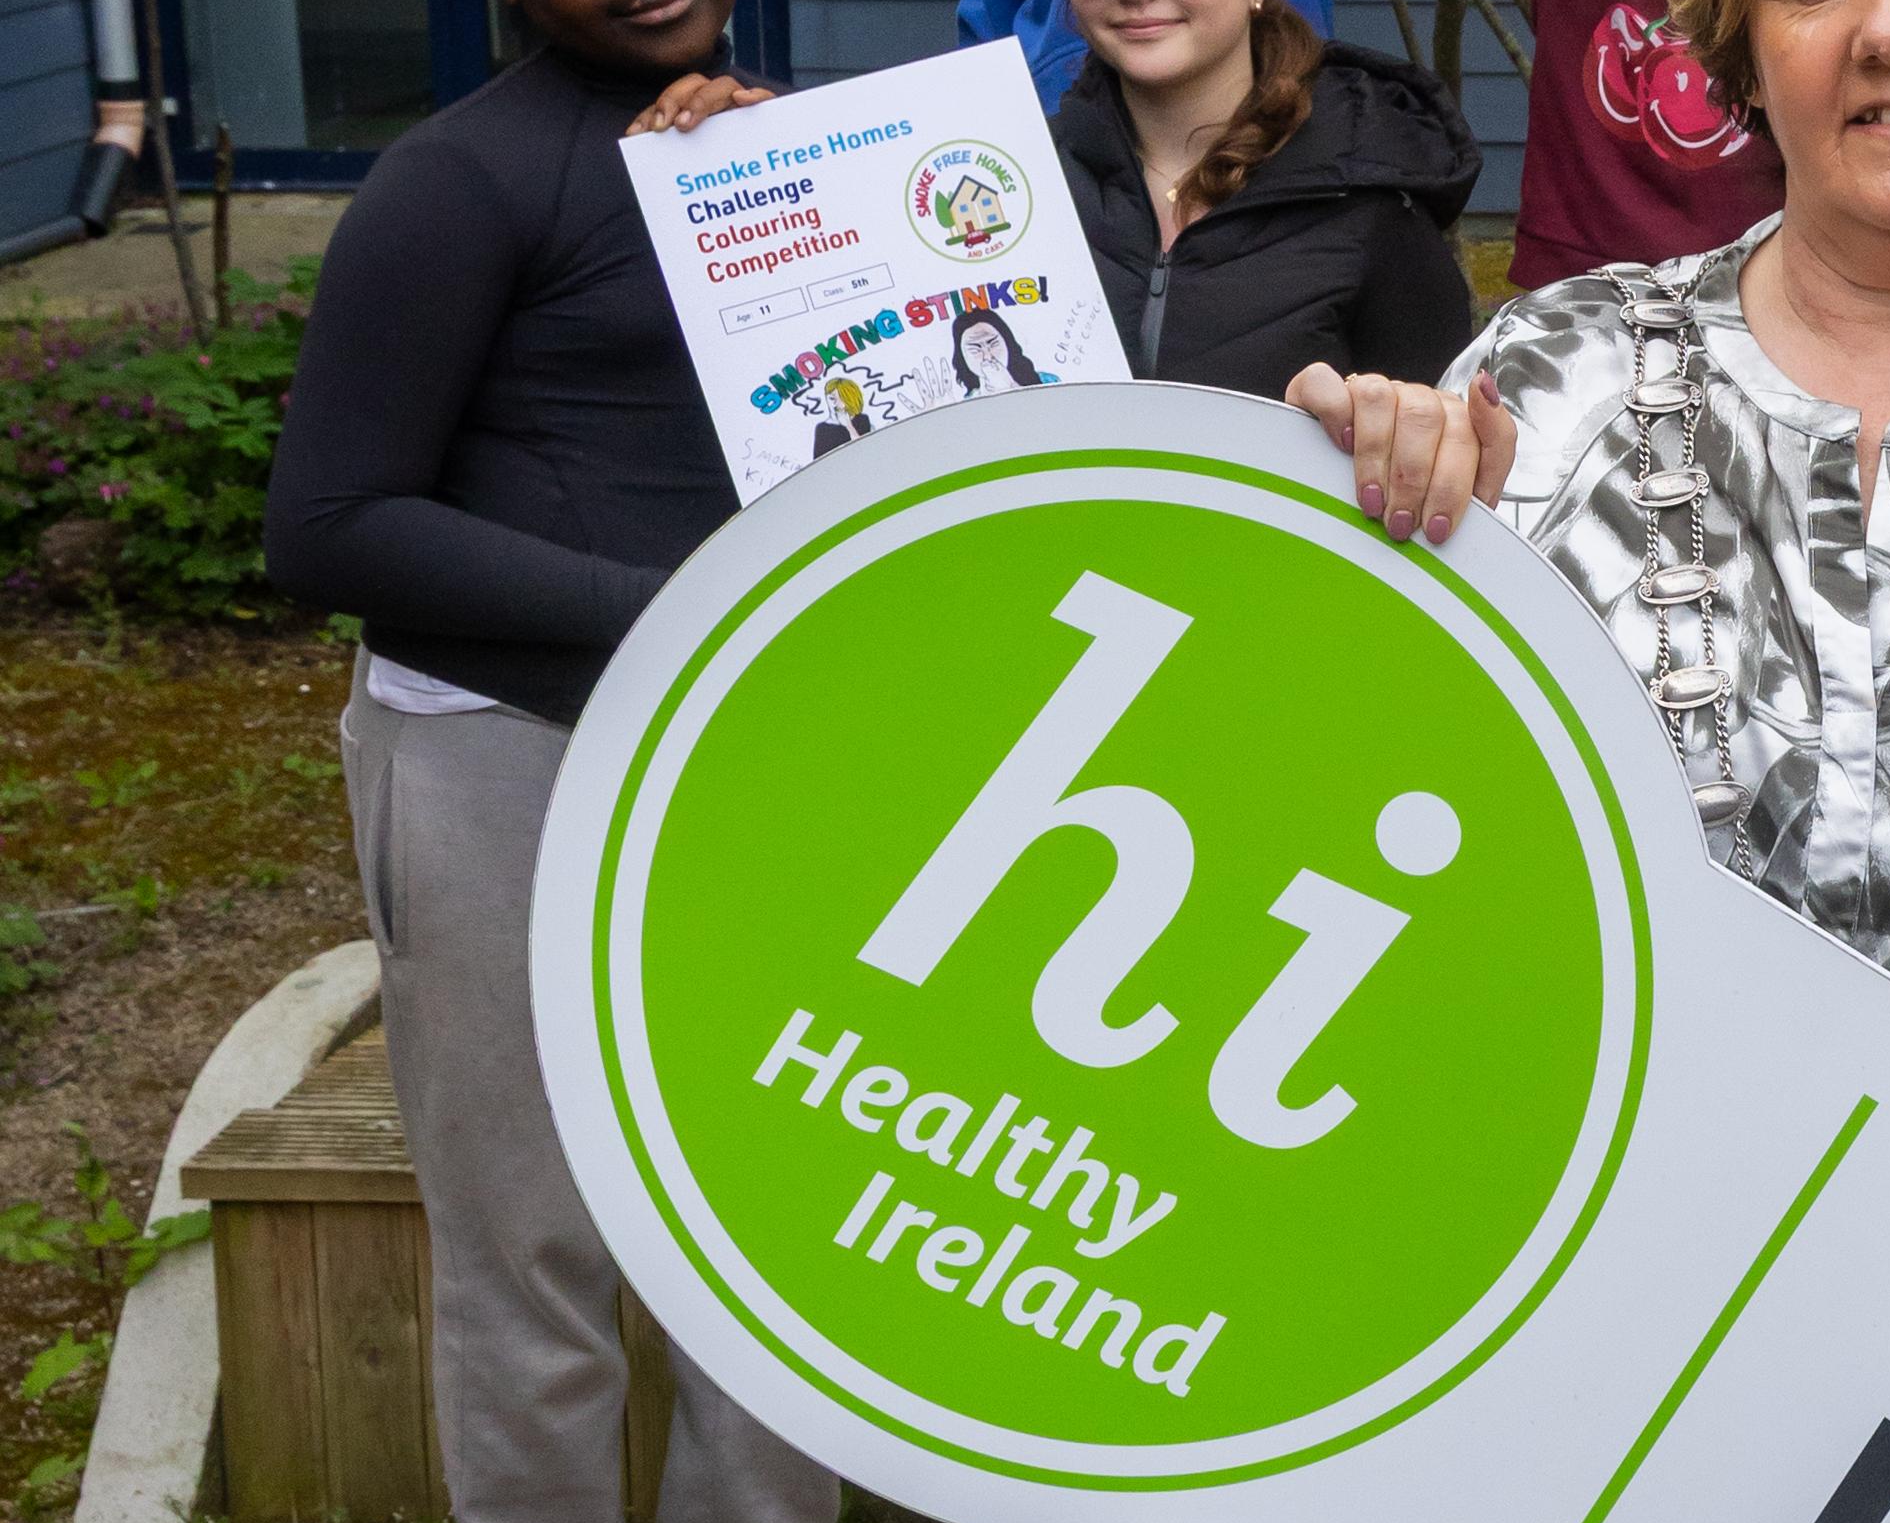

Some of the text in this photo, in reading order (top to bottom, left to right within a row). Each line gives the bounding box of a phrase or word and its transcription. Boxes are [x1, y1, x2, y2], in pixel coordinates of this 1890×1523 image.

[676, 118, 913, 196] Smoke Free Homes
[915, 150, 1017, 217] SMOKE FREE HOMES
[686, 177, 815, 225] Challenge
[697, 206, 822, 255] Colouring
[706, 226, 860, 284] Competition
[851, 277, 869, 289] 5th
[759, 304, 771, 316] 11
[751, 275, 1048, 415] SMOKING STINKS!
[855, 568, 1462, 1150] hi
[751, 1006, 1178, 1260] Healthy
[832, 1170, 1227, 1398] Ireland
